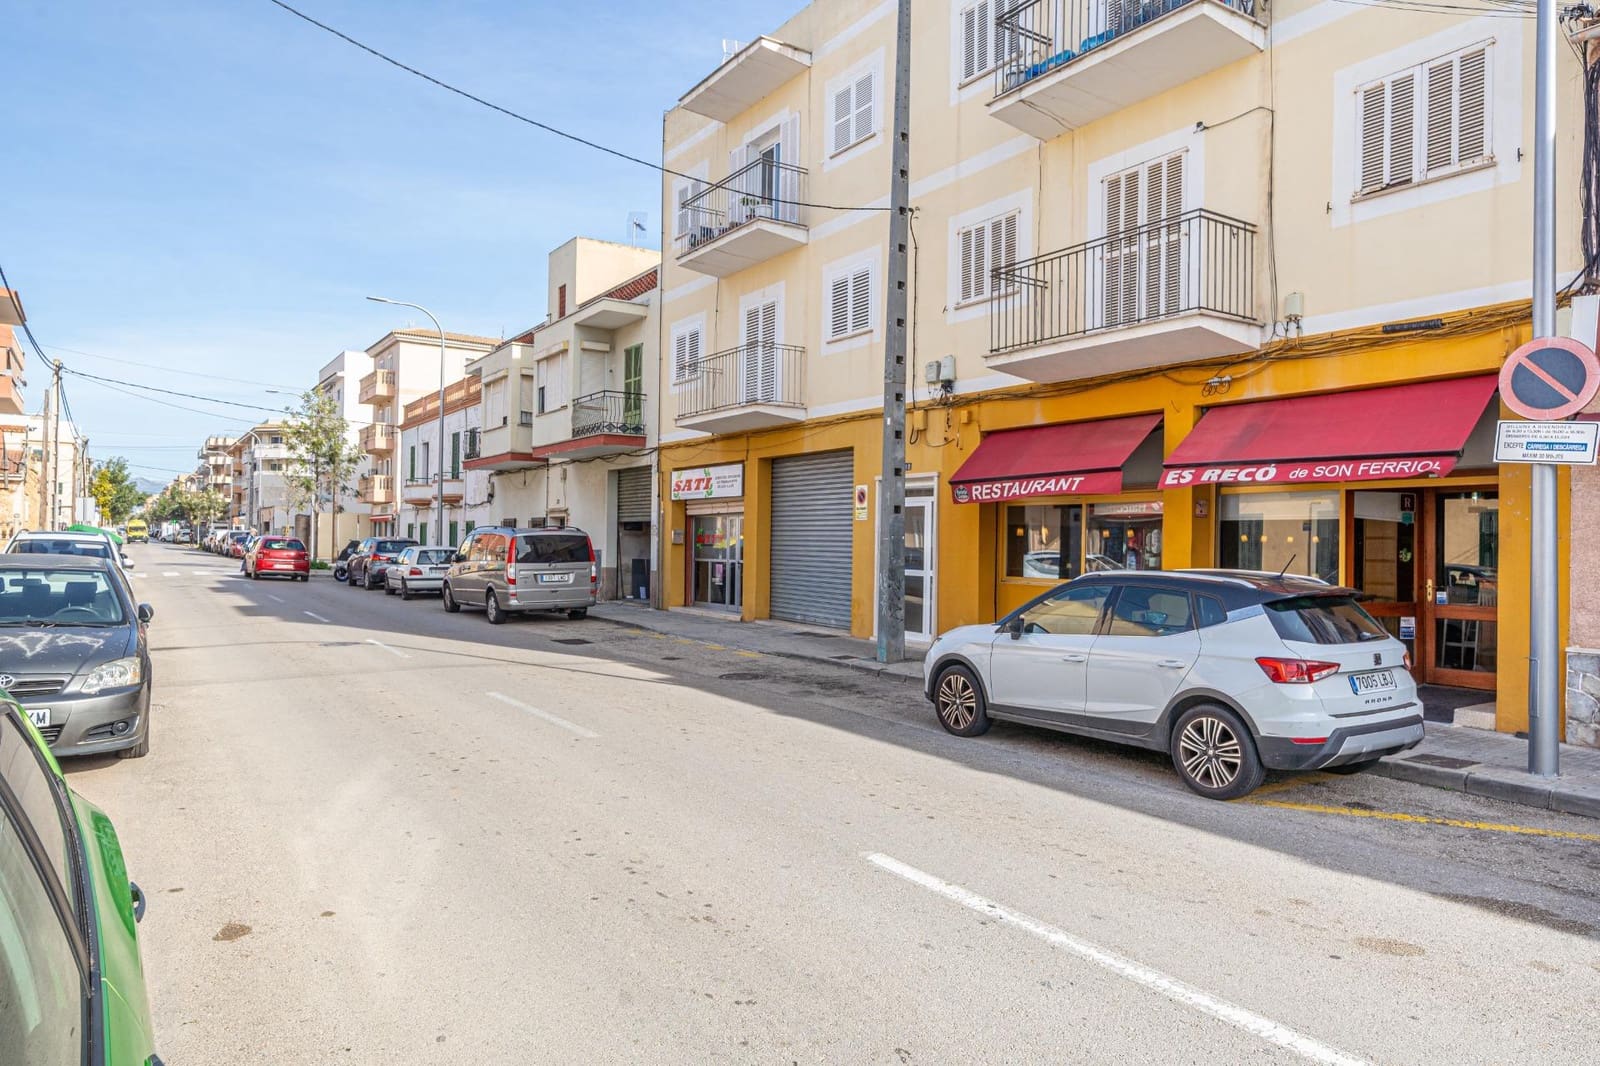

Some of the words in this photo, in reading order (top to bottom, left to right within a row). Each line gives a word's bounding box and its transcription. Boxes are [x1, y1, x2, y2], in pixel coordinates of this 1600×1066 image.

[1164, 469, 1193, 485] ES
[1200, 463, 1277, 482] RECÓ
[1289, 467, 1308, 479] de
[1312, 463, 1353, 477] SON
[673, 477, 713, 492] SATI
[971, 476, 1085, 501] RESTAURANT
[1404, 497, 1411, 508] R
[1356, 674, 1378, 689] 7005
[1379, 672, 1393, 687] LBJ
[1364, 696, 1392, 705] ARONA
